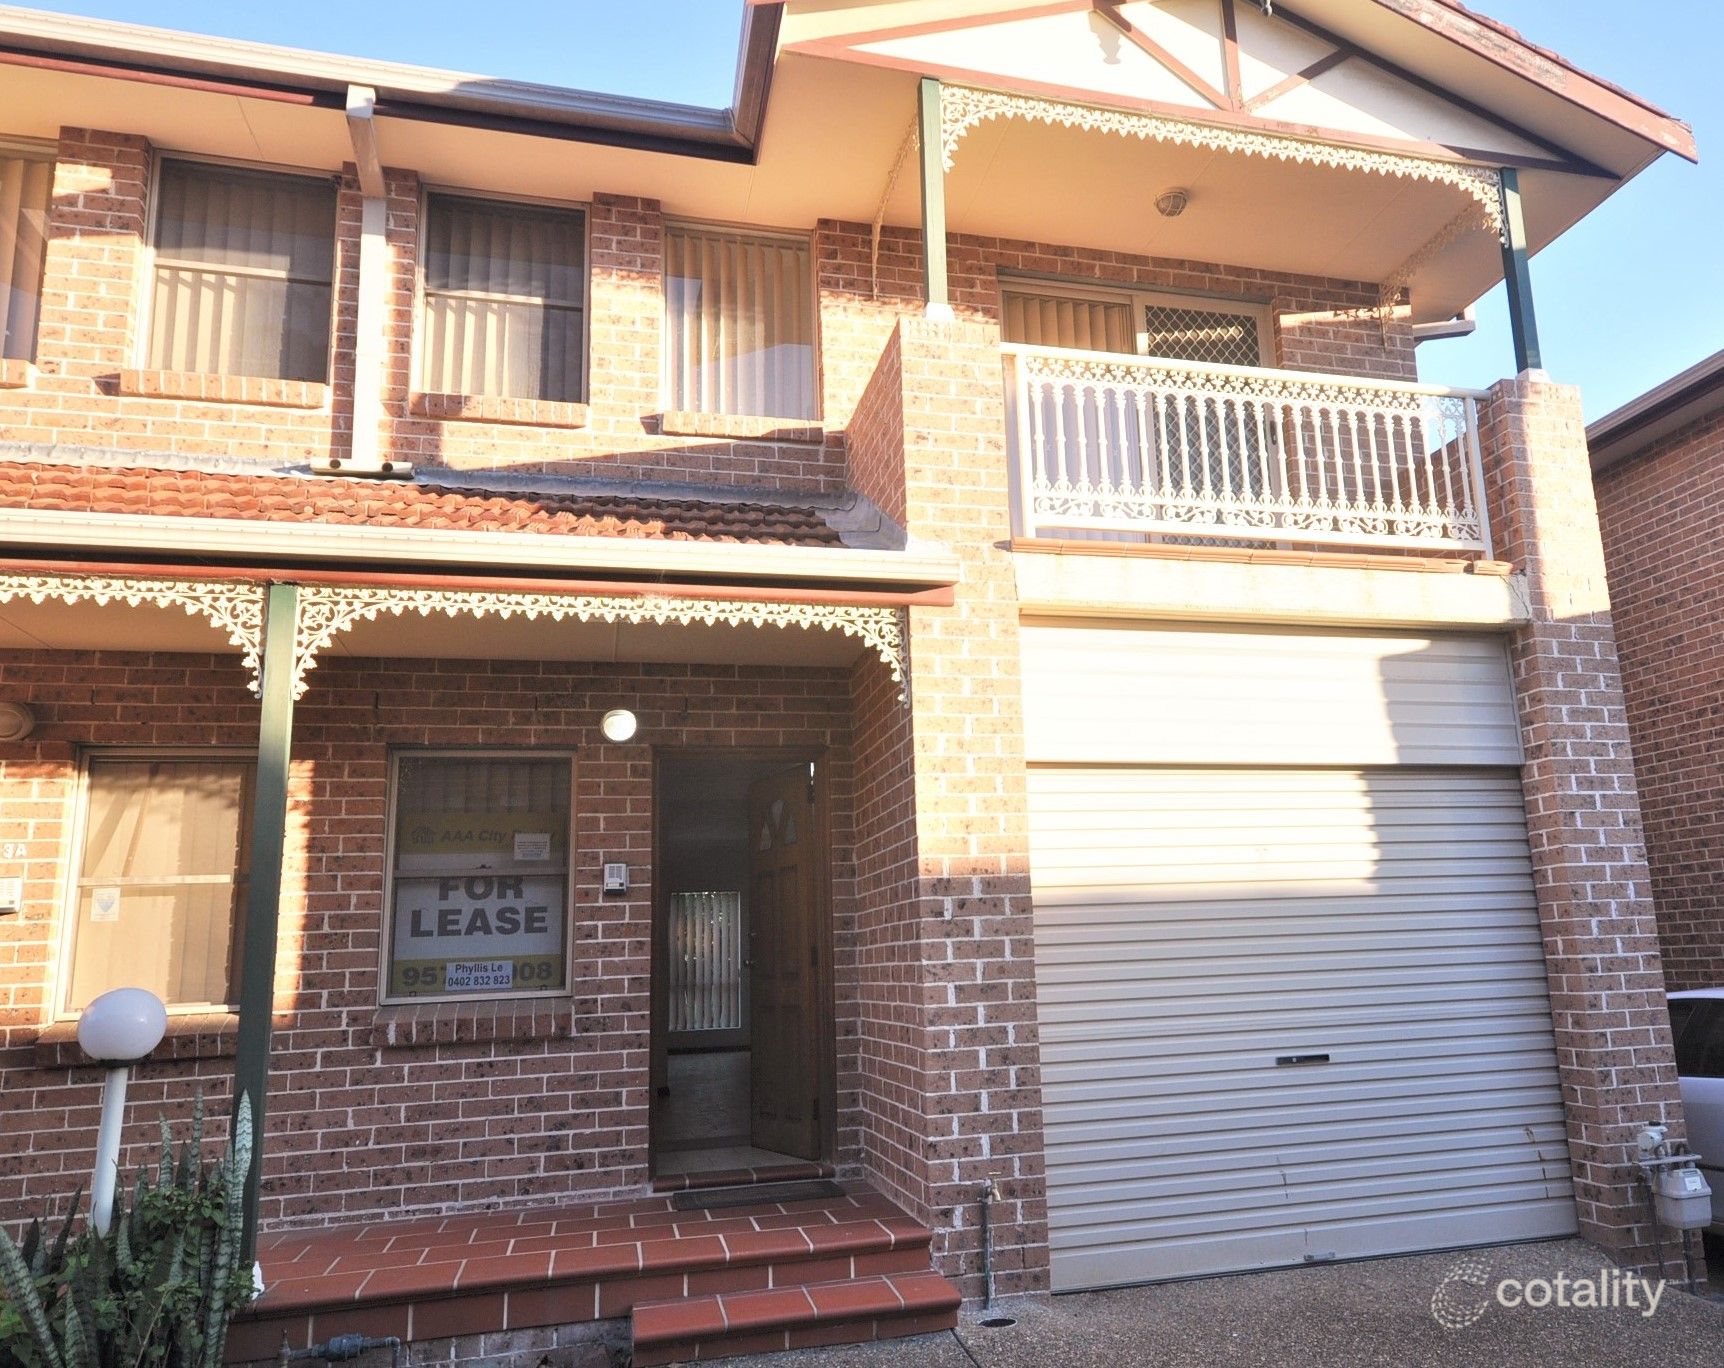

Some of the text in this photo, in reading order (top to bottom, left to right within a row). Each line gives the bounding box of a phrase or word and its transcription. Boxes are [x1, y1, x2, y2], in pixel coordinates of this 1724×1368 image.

[440, 829, 475, 843] AAA
[478, 829, 508, 844] City
[3, 843, 27, 859] 3A
[438, 876, 524, 900] FOR
[410, 906, 548, 938] LEASE
[455, 963, 503, 976] Phyllis Le
[447, 975, 511, 987] 0402 832 823
